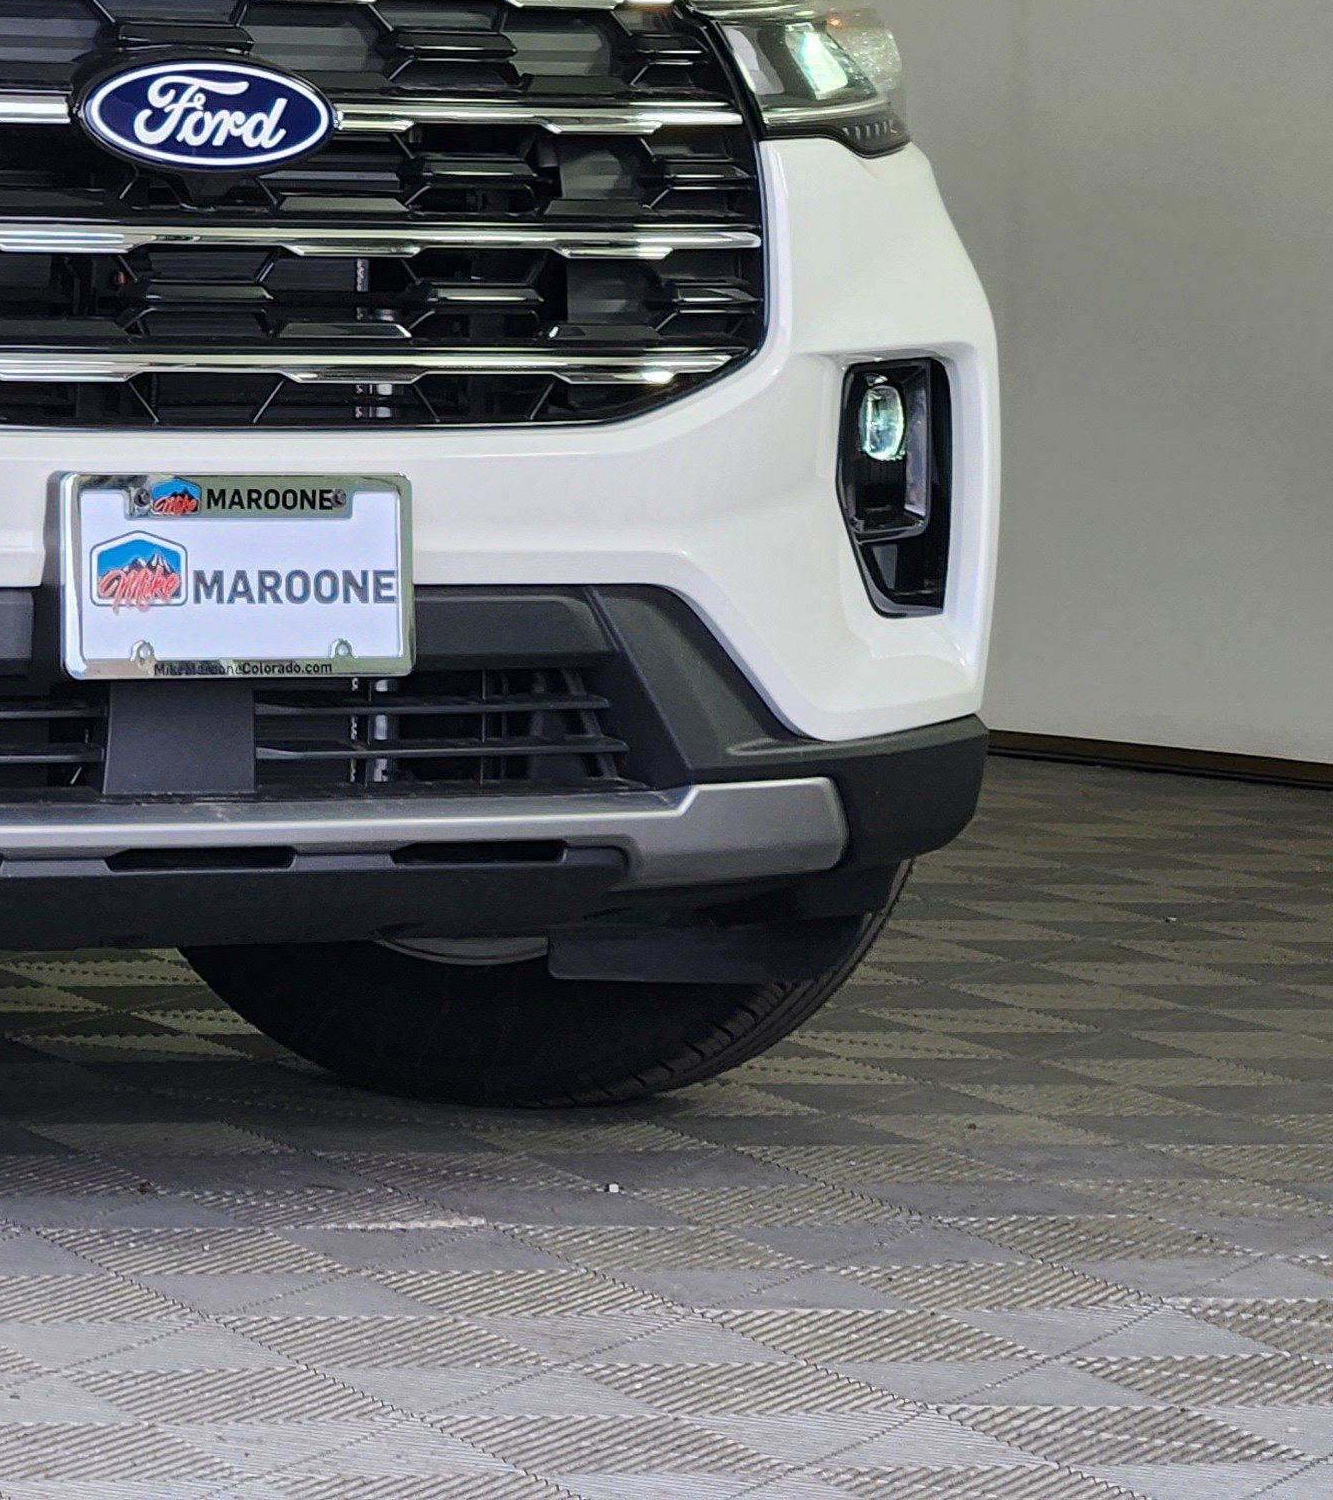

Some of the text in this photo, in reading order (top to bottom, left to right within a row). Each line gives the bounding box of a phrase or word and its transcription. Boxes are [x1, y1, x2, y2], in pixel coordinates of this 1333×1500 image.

[134, 75, 288, 149] Ford
[153, 488, 334, 515] Mike MAROONE
[98, 565, 397, 615] Mike MAROONE
